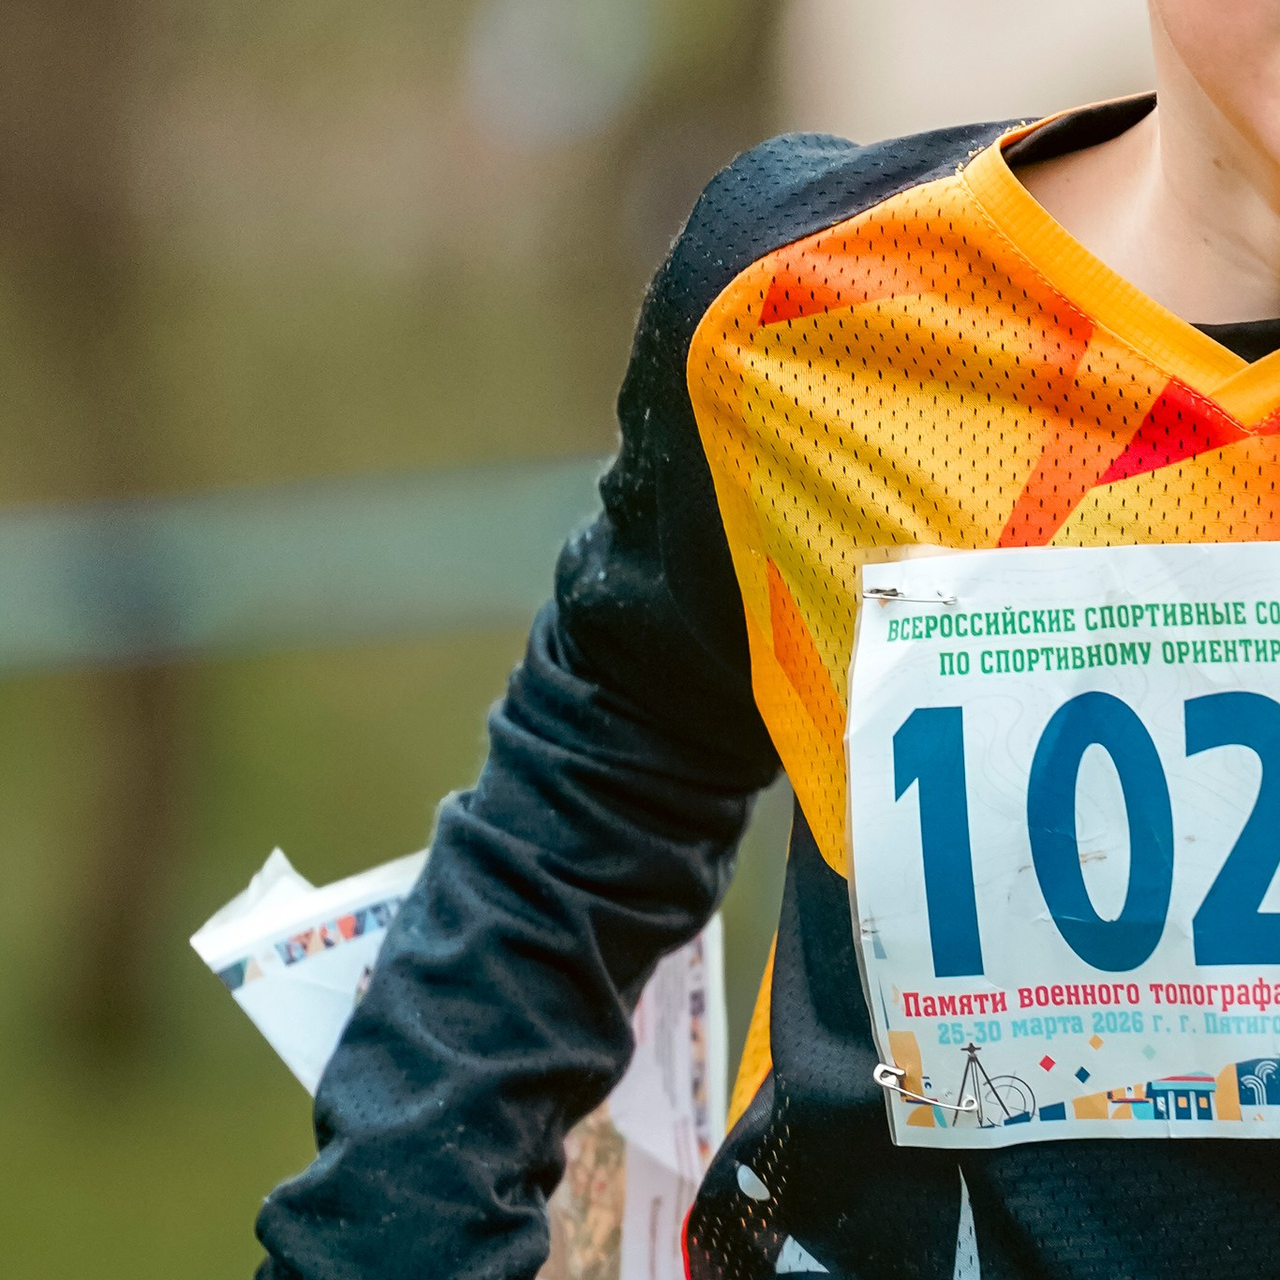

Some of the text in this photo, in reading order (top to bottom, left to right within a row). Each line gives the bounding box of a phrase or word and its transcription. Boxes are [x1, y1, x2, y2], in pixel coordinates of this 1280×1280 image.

[887, 606, 1078, 643] ВСЕРОССИЙСКИЕ
[1085, 600, 1247, 631] СПОРТИВНЫЕ
[939, 651, 971, 676] ПО
[980, 641, 1152, 674] СПОРТИВНОМУ
[903, 991, 1008, 1018] Памяти
[1018, 983, 1140, 1008] военного
[937, 1020, 1002, 1045] 25-30
[1011, 1014, 1085, 1040] марта
[1092, 1010, 1145, 1035] 2026
